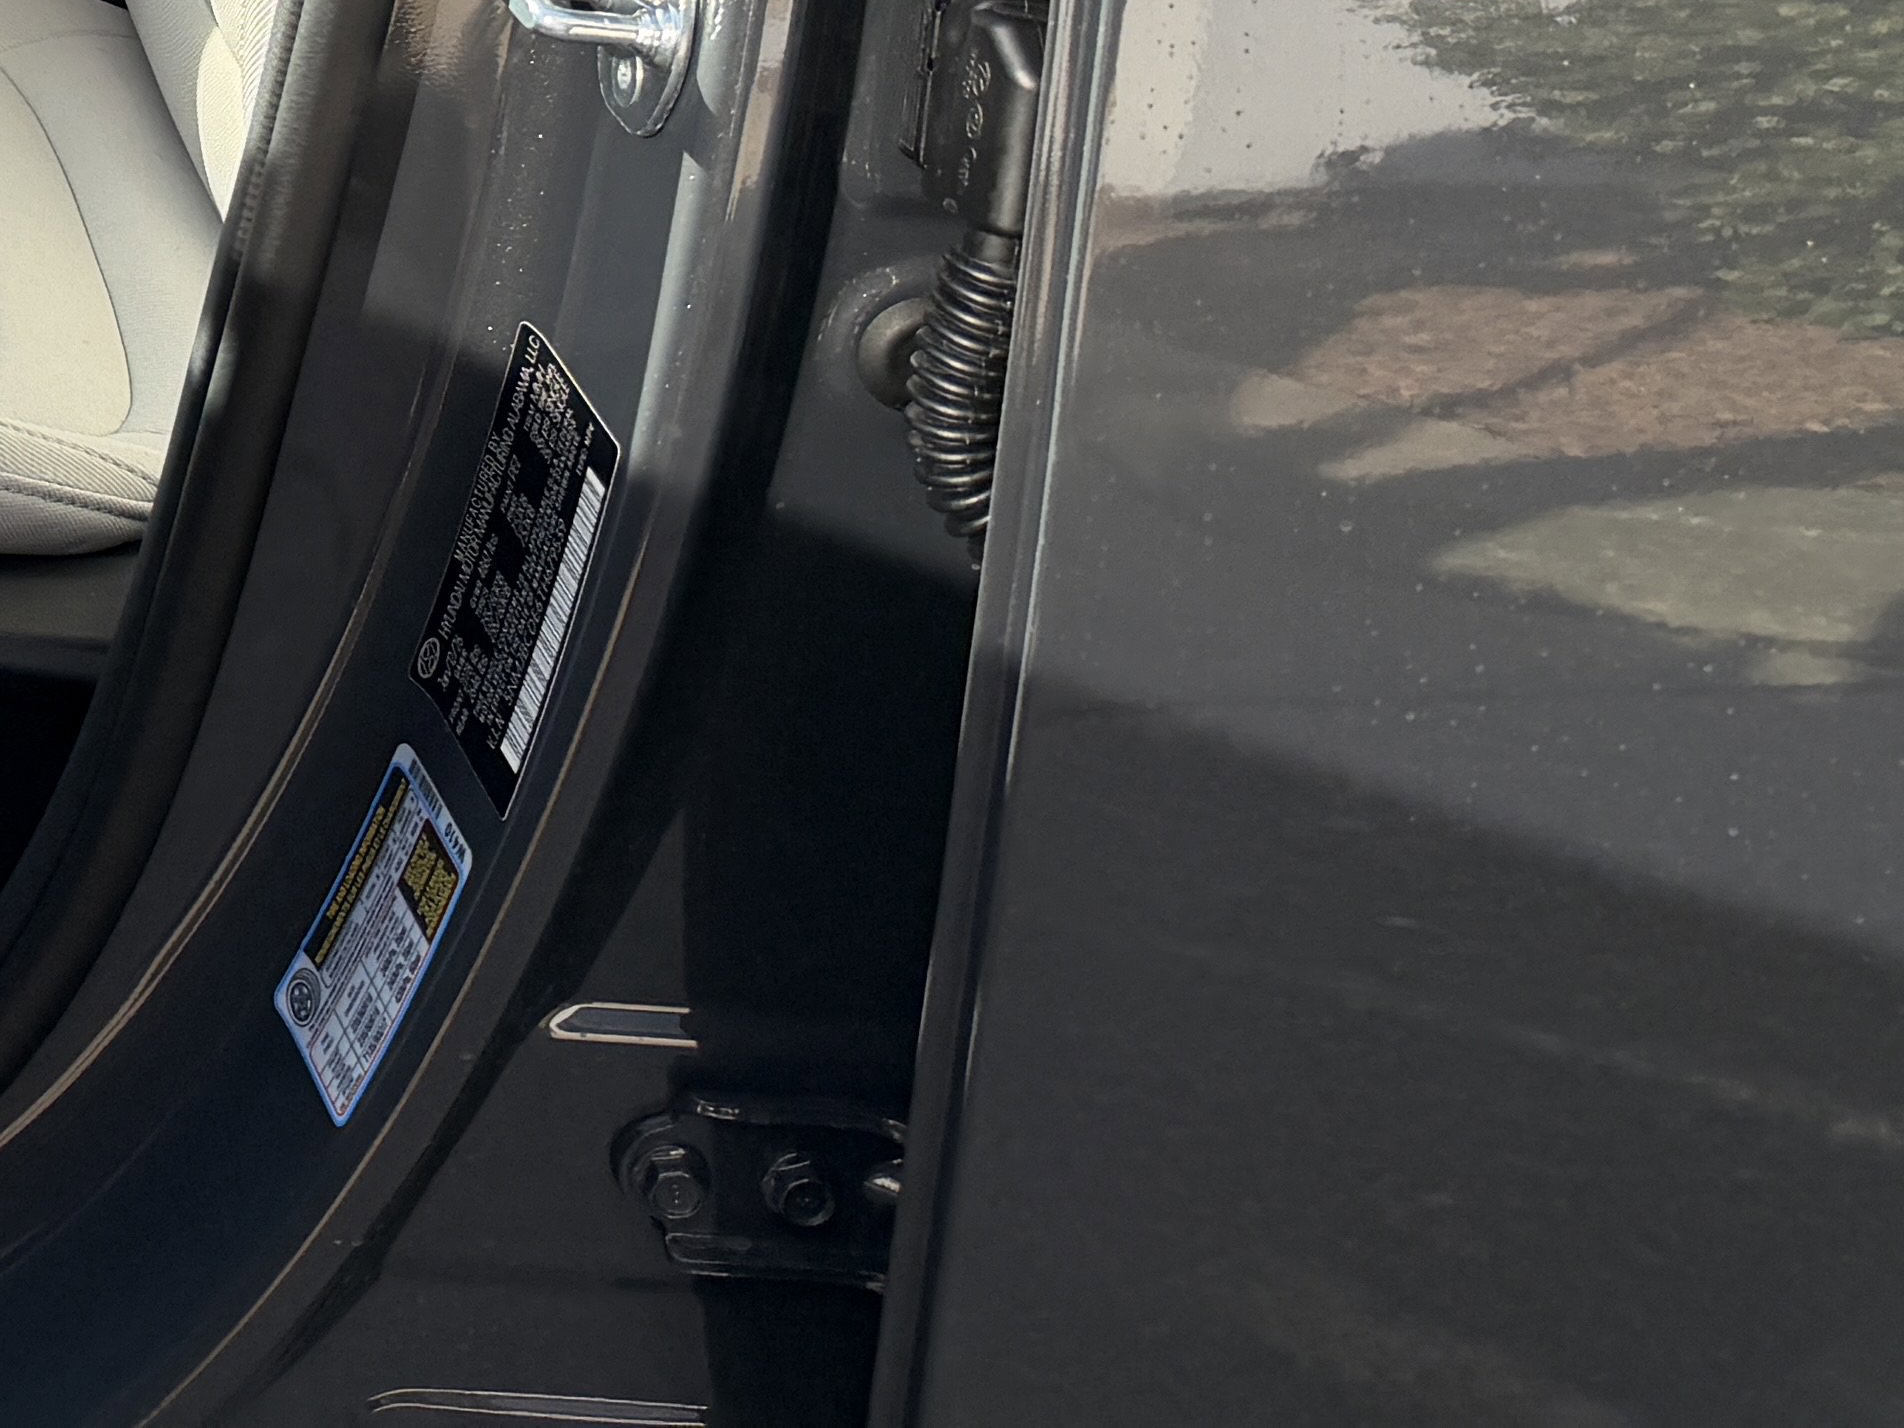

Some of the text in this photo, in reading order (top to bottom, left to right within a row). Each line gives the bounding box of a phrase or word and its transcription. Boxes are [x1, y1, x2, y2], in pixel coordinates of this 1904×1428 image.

[438, 581, 465, 640] HYUNDAI
[460, 531, 482, 582] MOTOR
[525, 334, 541, 364] LLC
